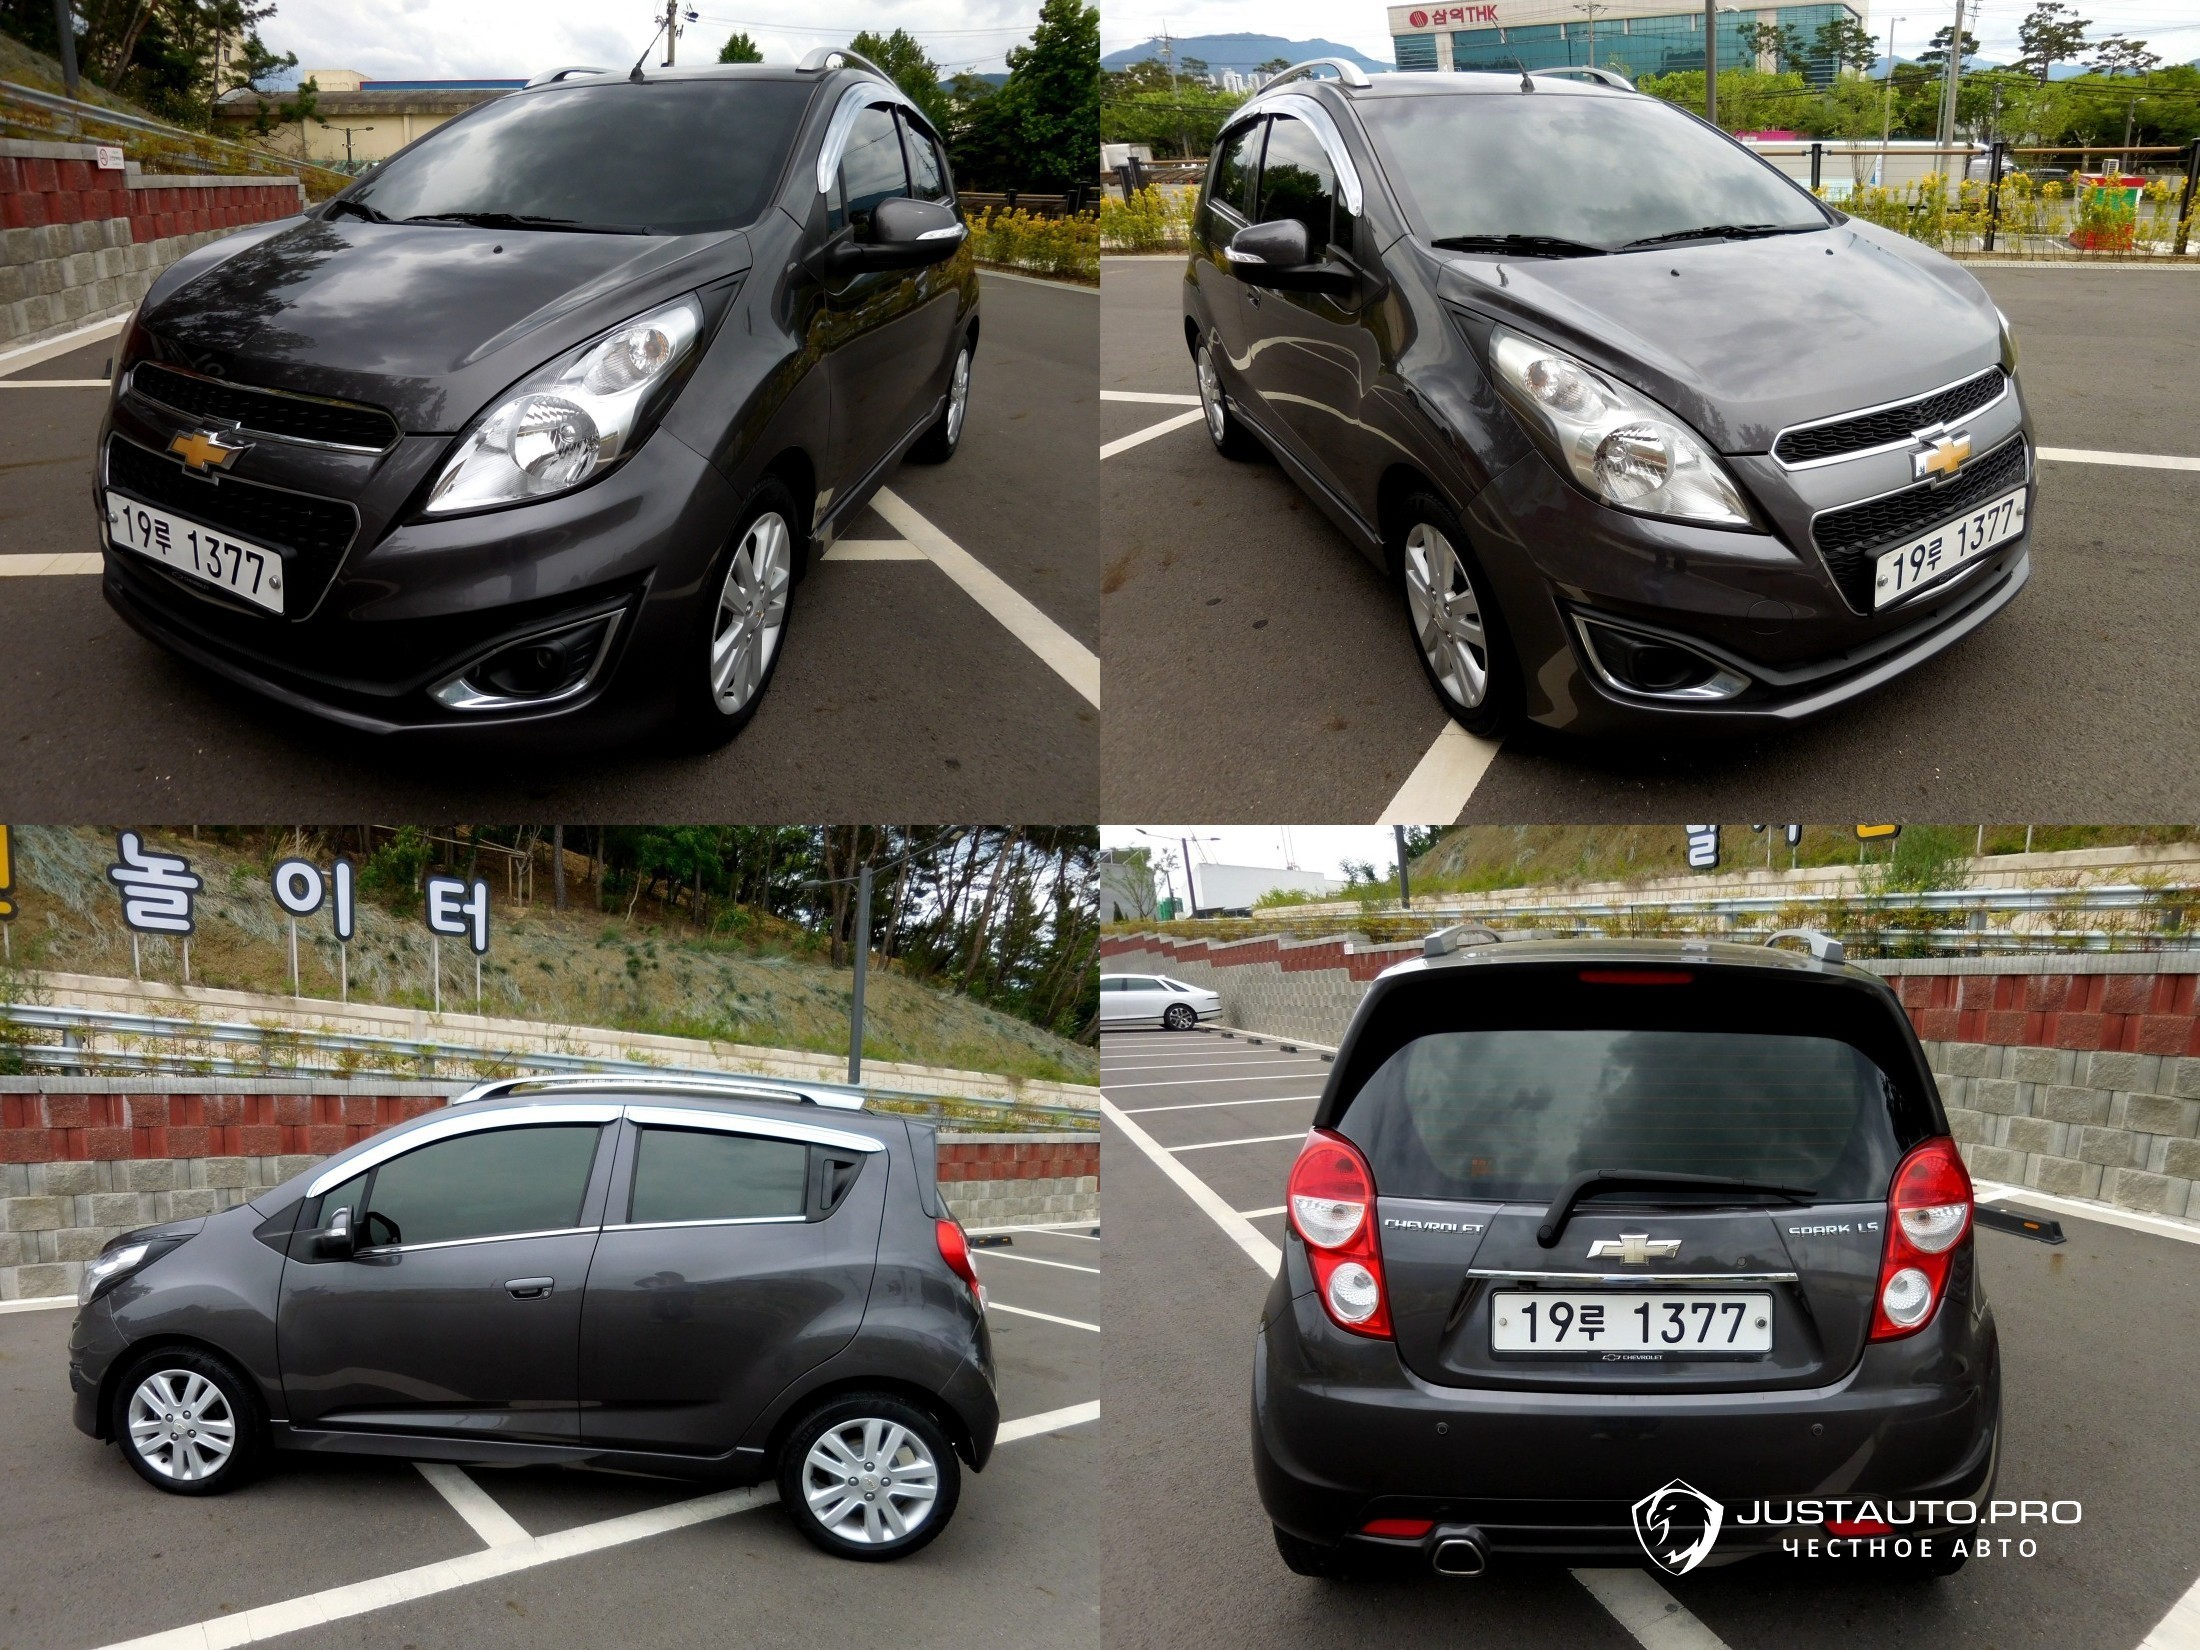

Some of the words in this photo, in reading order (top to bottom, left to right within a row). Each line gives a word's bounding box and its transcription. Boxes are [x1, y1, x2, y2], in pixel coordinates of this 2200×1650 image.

[122, 505, 172, 555] 19루
[187, 529, 265, 594] 1377
[1893, 536, 1943, 591] 19루
[1957, 498, 2015, 557] 1377
[1384, 1218, 1485, 1235] CHEVROLET
[1788, 1223, 1850, 1238] SPARK
[1857, 1221, 1880, 1233] LS
[1520, 1301, 1606, 1343] 19루
[1633, 1301, 1747, 1344] 1377
